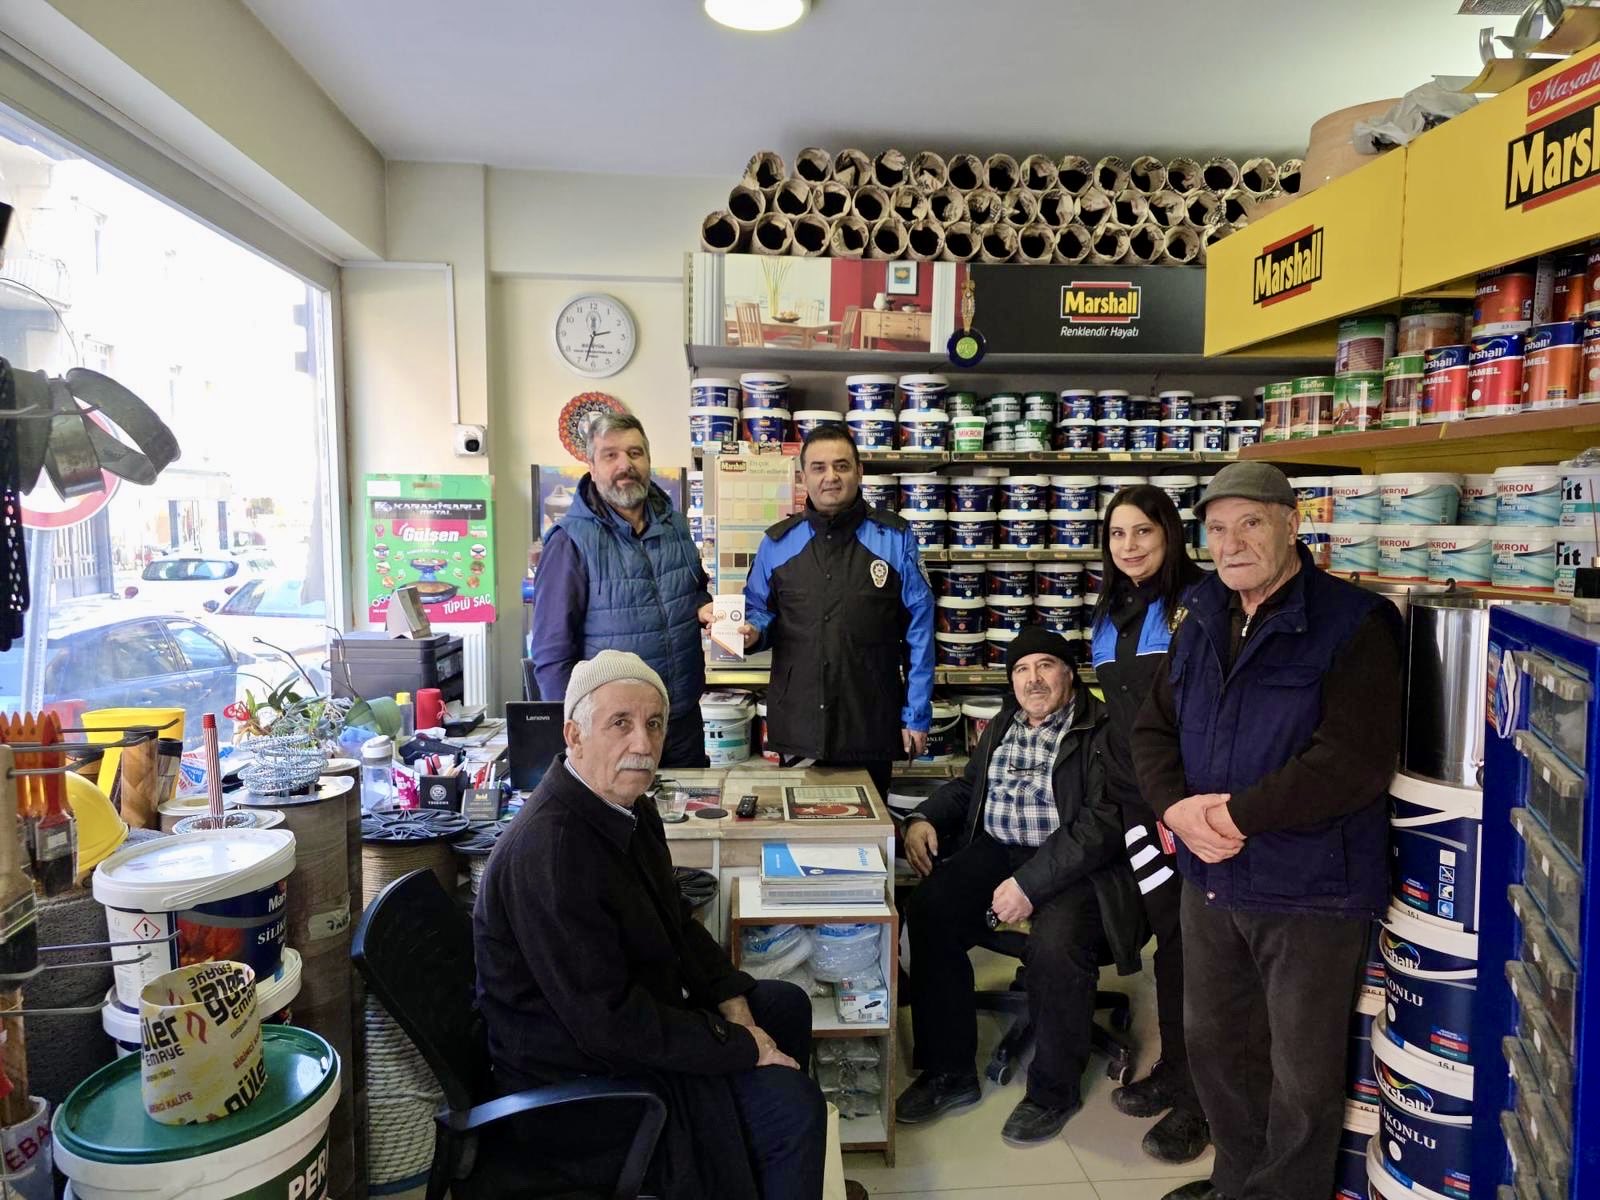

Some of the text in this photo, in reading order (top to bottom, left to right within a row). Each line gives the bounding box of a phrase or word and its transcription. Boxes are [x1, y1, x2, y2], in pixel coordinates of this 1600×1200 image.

[1255, 231, 1322, 301] Marshall
[1064, 291, 1138, 314] Marshall
[1060, 326, 1139, 339] Renklendir Hayatı
[1468, 347, 1502, 361] arshall
[1524, 339, 1546, 351] rshall
[1561, 476, 1582, 500] Fit
[403, 527, 460, 545] Gülşen
[1556, 541, 1581, 566] Fit
[443, 599, 471, 614] TÜPLÜ
[146, 1044, 185, 1067] EMAYE
[288, 1148, 326, 1200] PER
